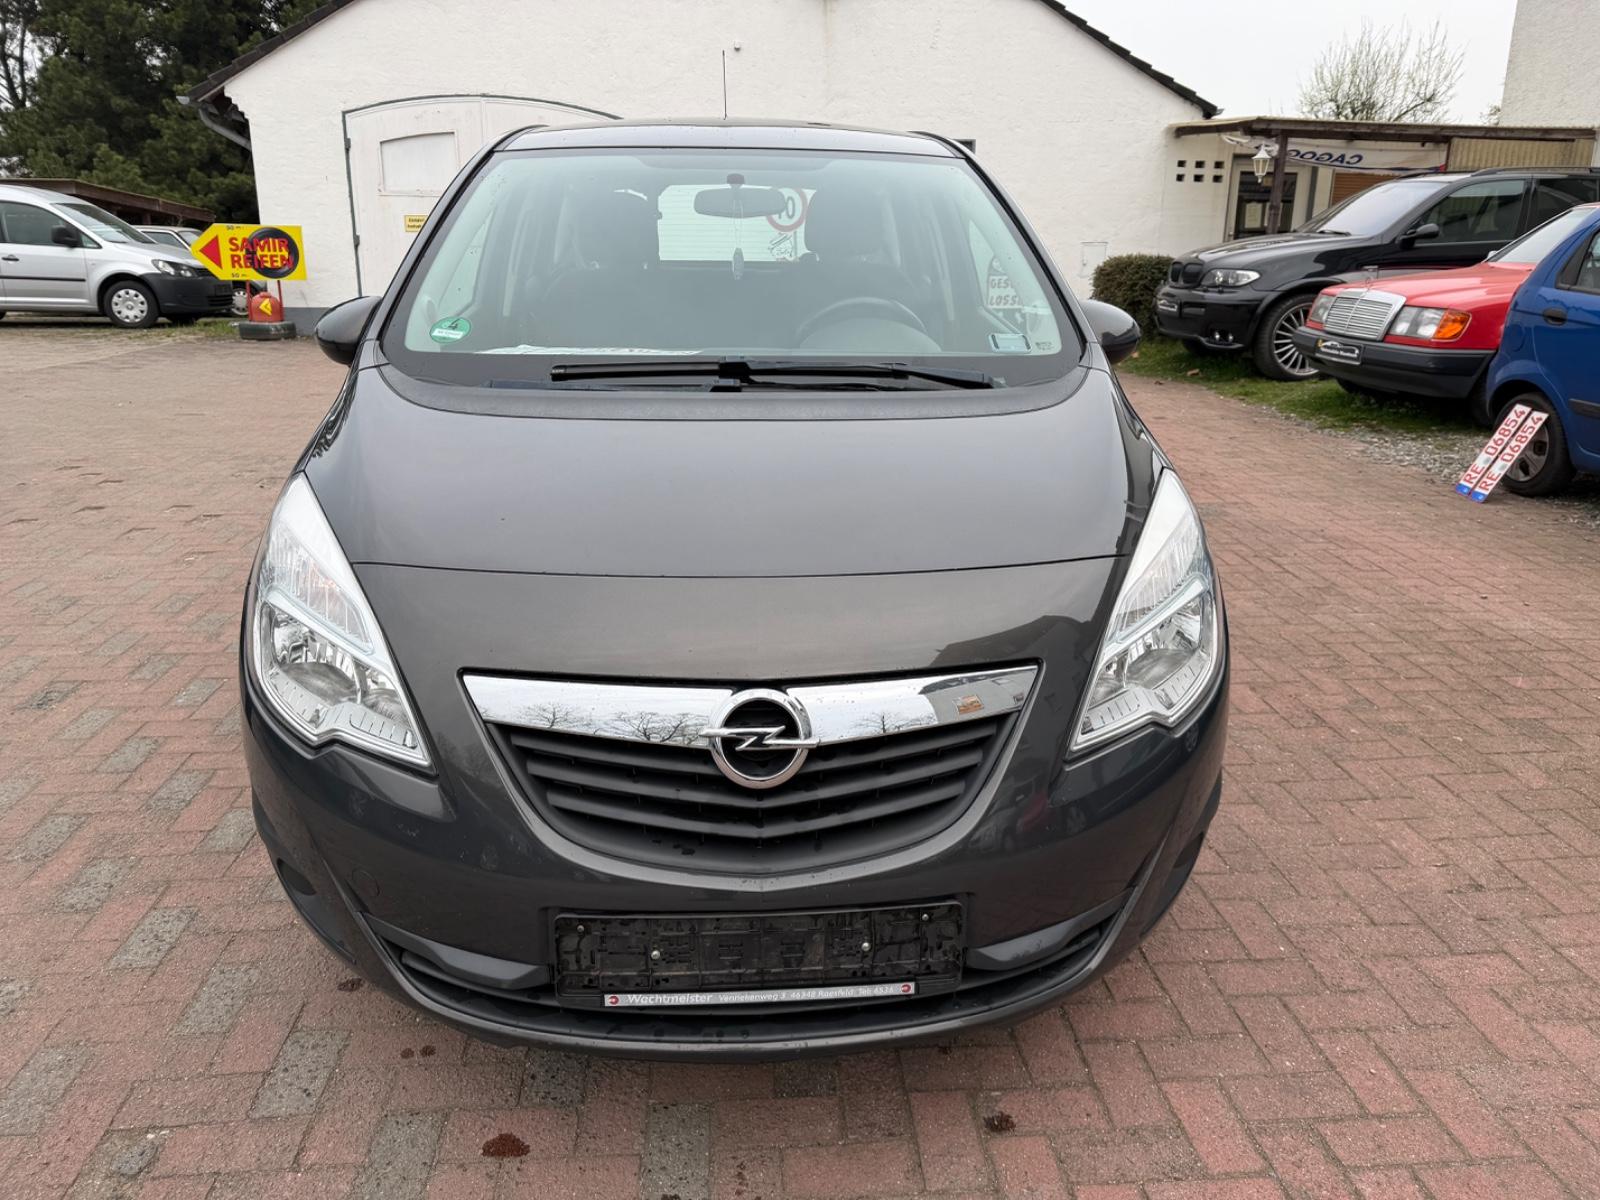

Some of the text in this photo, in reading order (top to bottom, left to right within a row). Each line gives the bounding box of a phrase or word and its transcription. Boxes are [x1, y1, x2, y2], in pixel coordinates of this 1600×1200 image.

[228, 237, 289, 253] SAMIR
[230, 254, 294, 269] REIFEN
[447, 318, 460, 331] 4
[1464, 409, 1526, 484] RE 06854
[1479, 416, 1543, 491] RE 06854
[627, 993, 713, 1004] Wachtmeister
